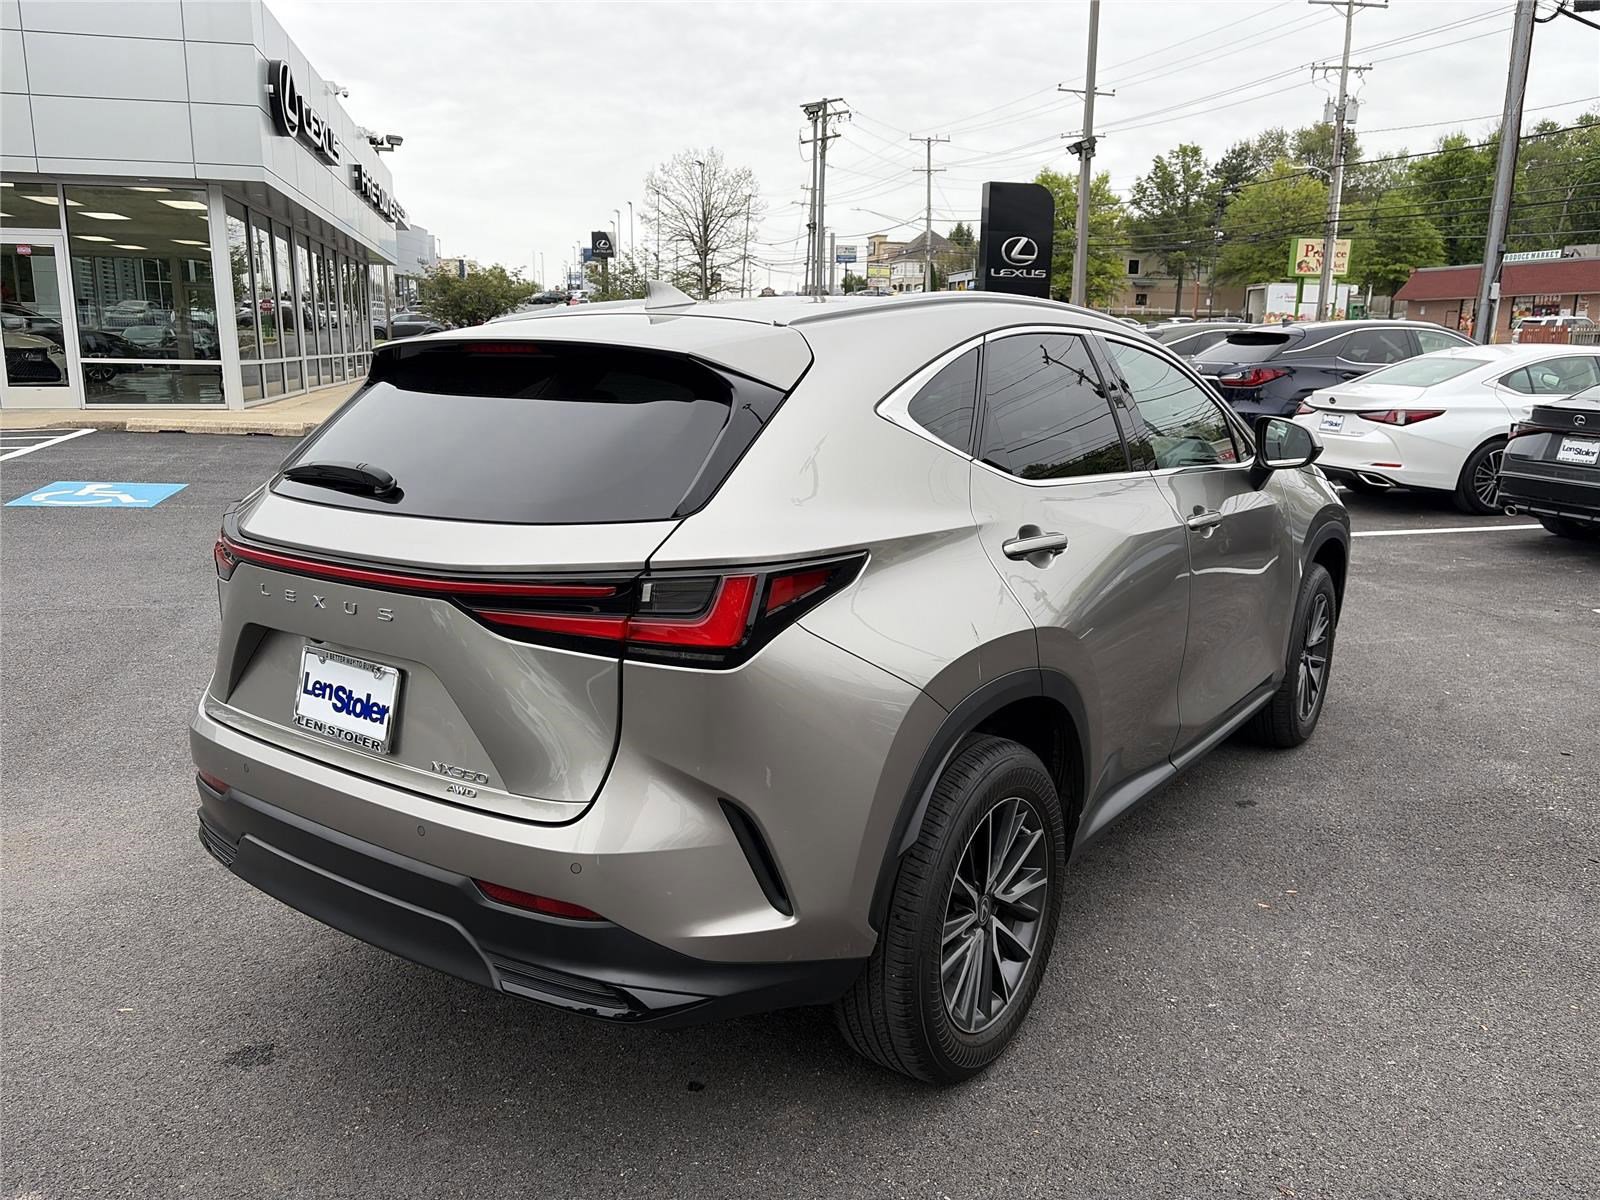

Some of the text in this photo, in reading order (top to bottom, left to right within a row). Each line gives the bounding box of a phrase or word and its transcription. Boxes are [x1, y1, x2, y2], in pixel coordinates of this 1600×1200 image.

[297, 95, 342, 166] LEXUS
[1530, 250, 1560, 260] MARKET
[990, 268, 1047, 278] LEXUS
[261, 583, 394, 622] LEXUS
[297, 716, 381, 751] LEN STOLER
[446, 784, 478, 799] AWD
